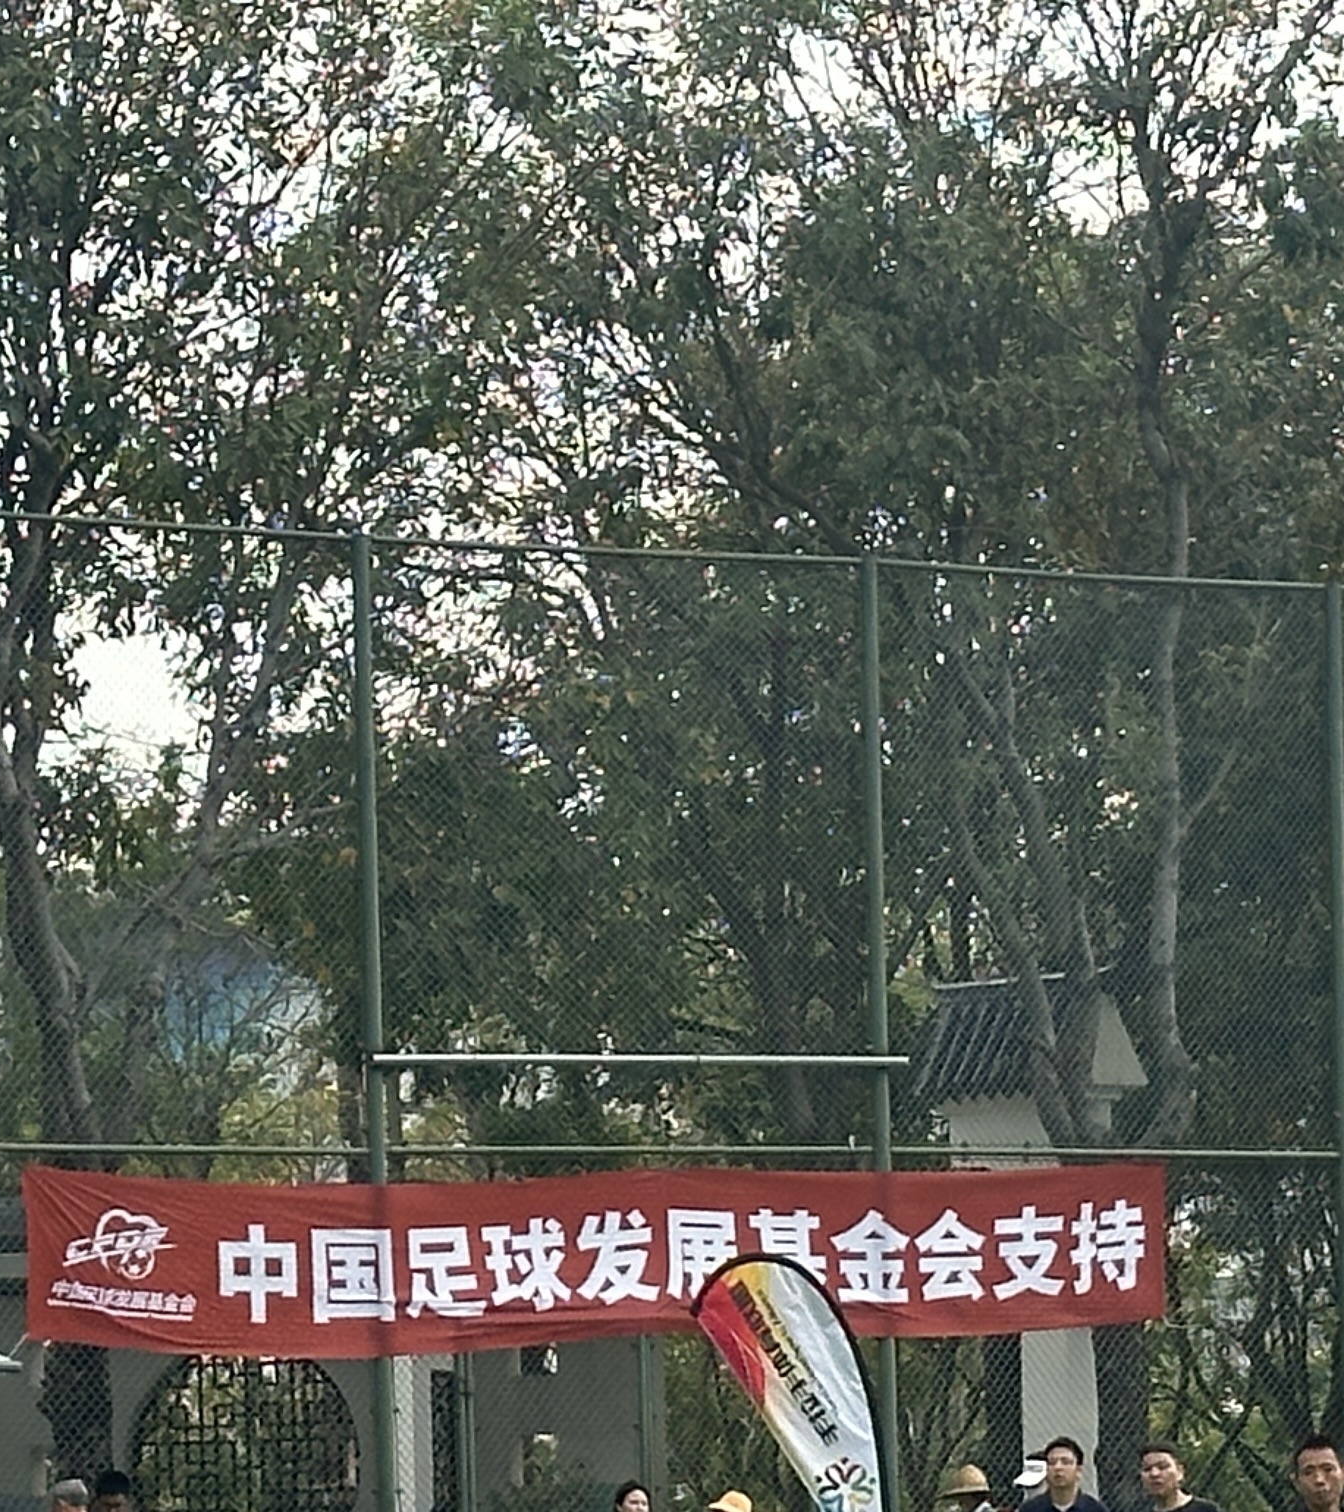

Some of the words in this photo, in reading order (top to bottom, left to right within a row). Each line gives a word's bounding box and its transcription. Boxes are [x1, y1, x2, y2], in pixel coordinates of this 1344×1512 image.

[218, 1200, 1146, 1324] 中国足球发展基金会支持
